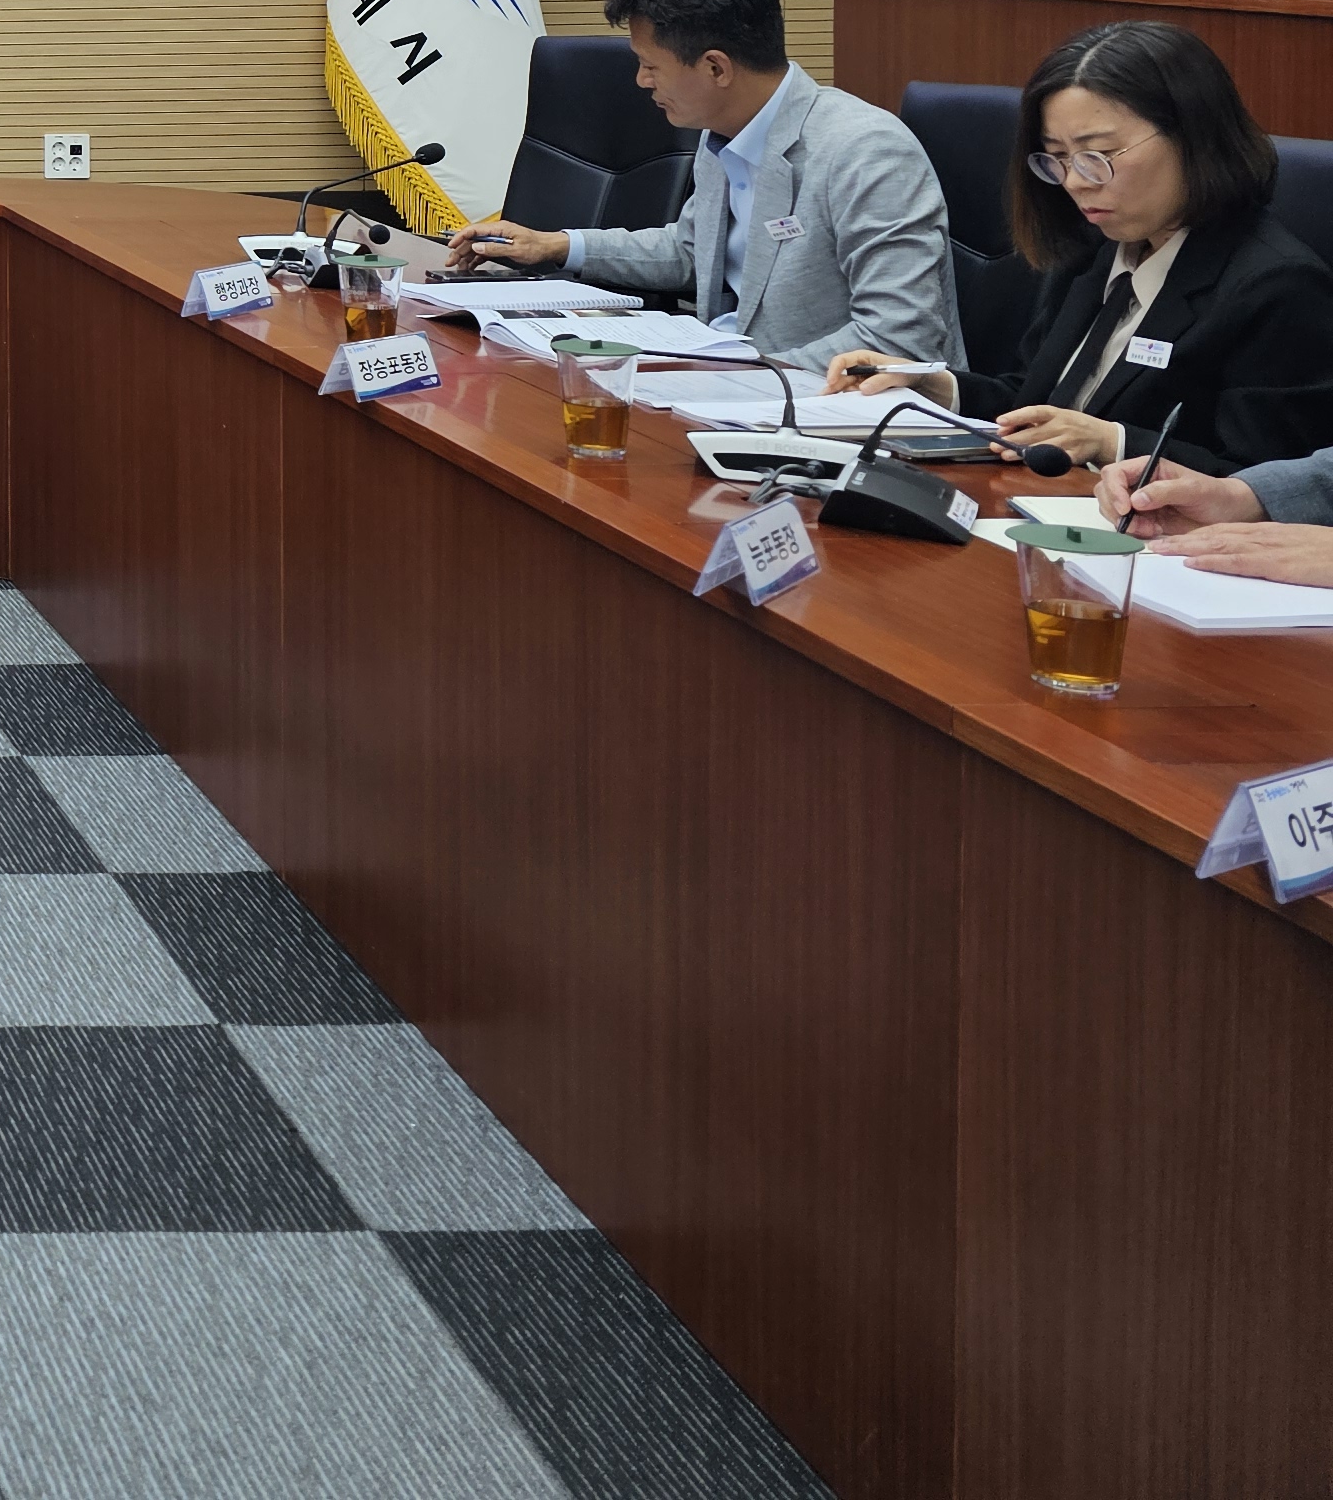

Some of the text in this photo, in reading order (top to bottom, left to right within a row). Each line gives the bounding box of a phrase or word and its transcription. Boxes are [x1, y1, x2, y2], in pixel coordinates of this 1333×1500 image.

[214, 276, 260, 302] 행정과장
[358, 350, 429, 382] 장승포동장
[774, 442, 817, 456] BOSCH
[747, 522, 800, 572] 능포동장
